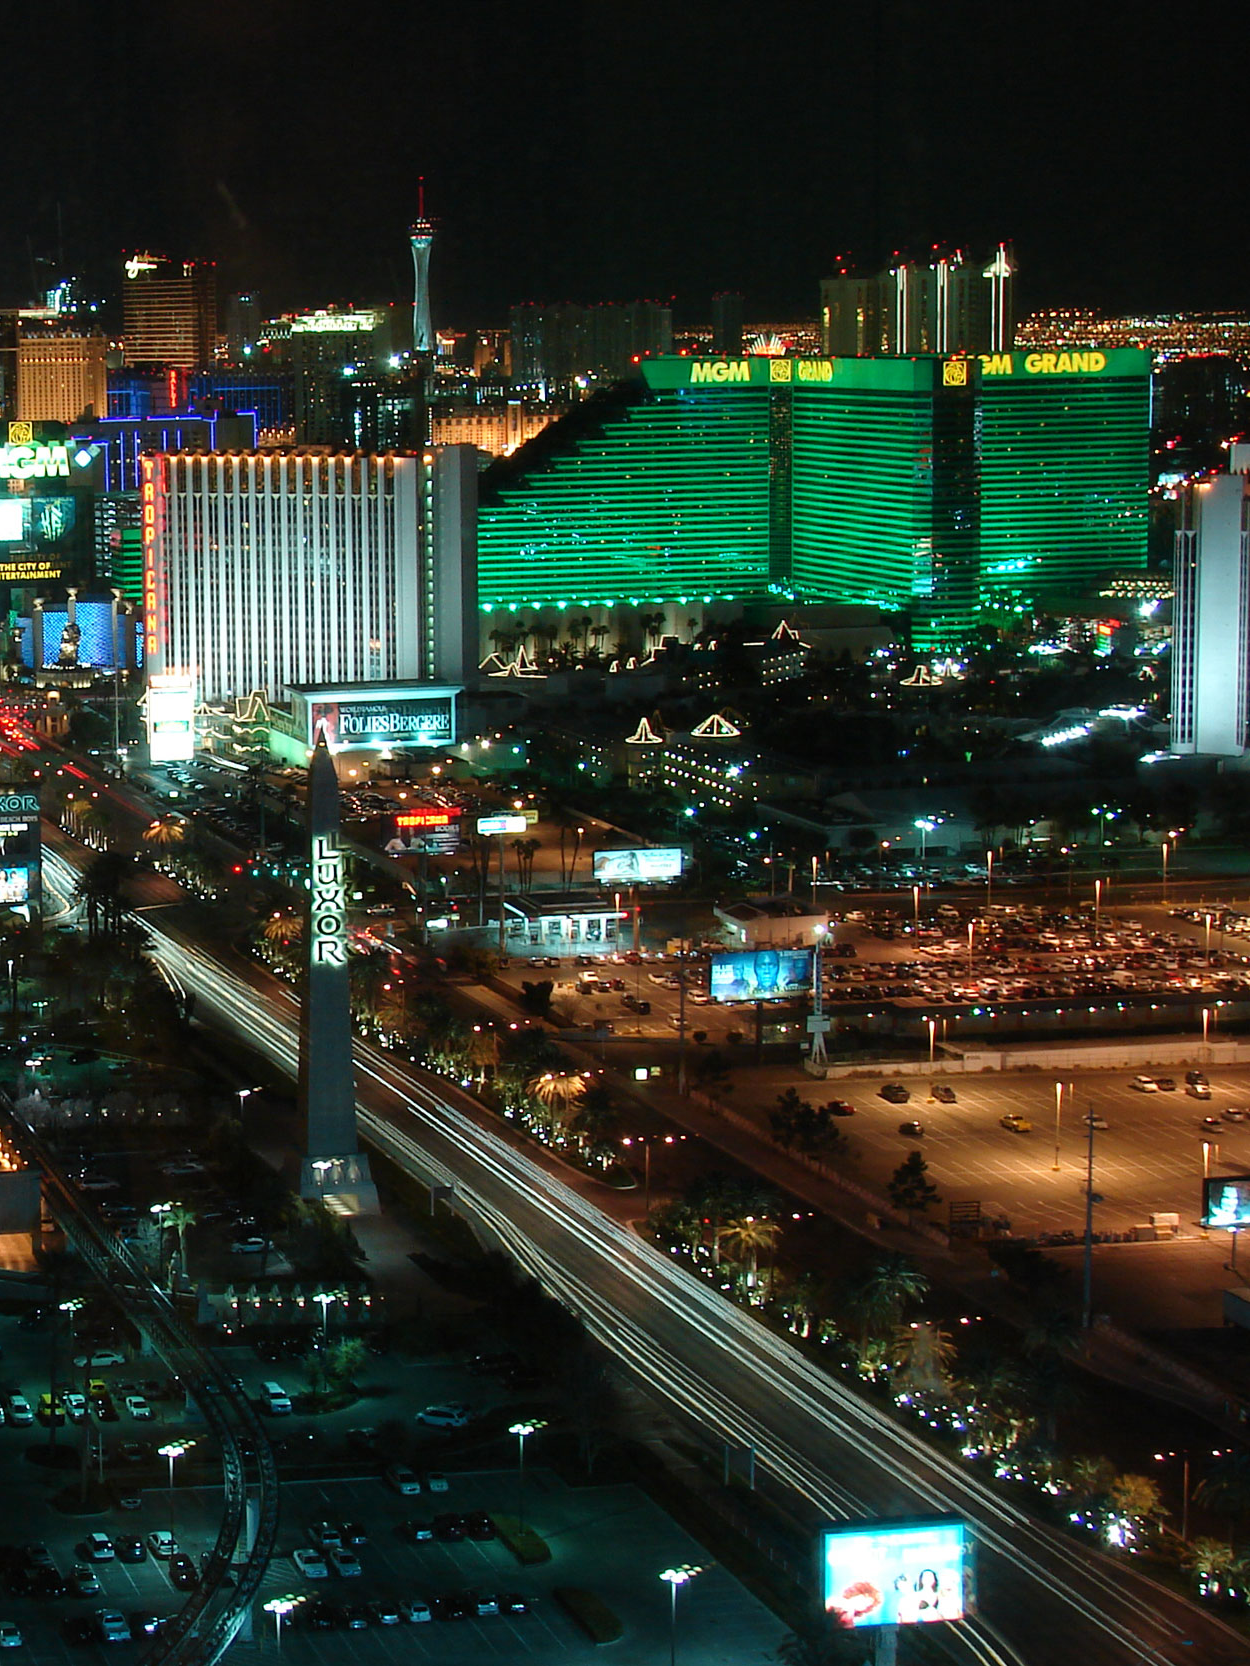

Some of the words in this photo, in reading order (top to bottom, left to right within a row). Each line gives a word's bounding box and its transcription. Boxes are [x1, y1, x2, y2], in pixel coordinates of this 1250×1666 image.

[690, 360, 751, 383] MGM
[797, 360, 834, 382] GRAND
[1025, 351, 1107, 374] GRAND
[17, 562, 37, 571] CITY
[38, 561, 51, 571] OF
[142, 460, 159, 655] TROPICANA
[312, 836, 346, 964] LUXOR
